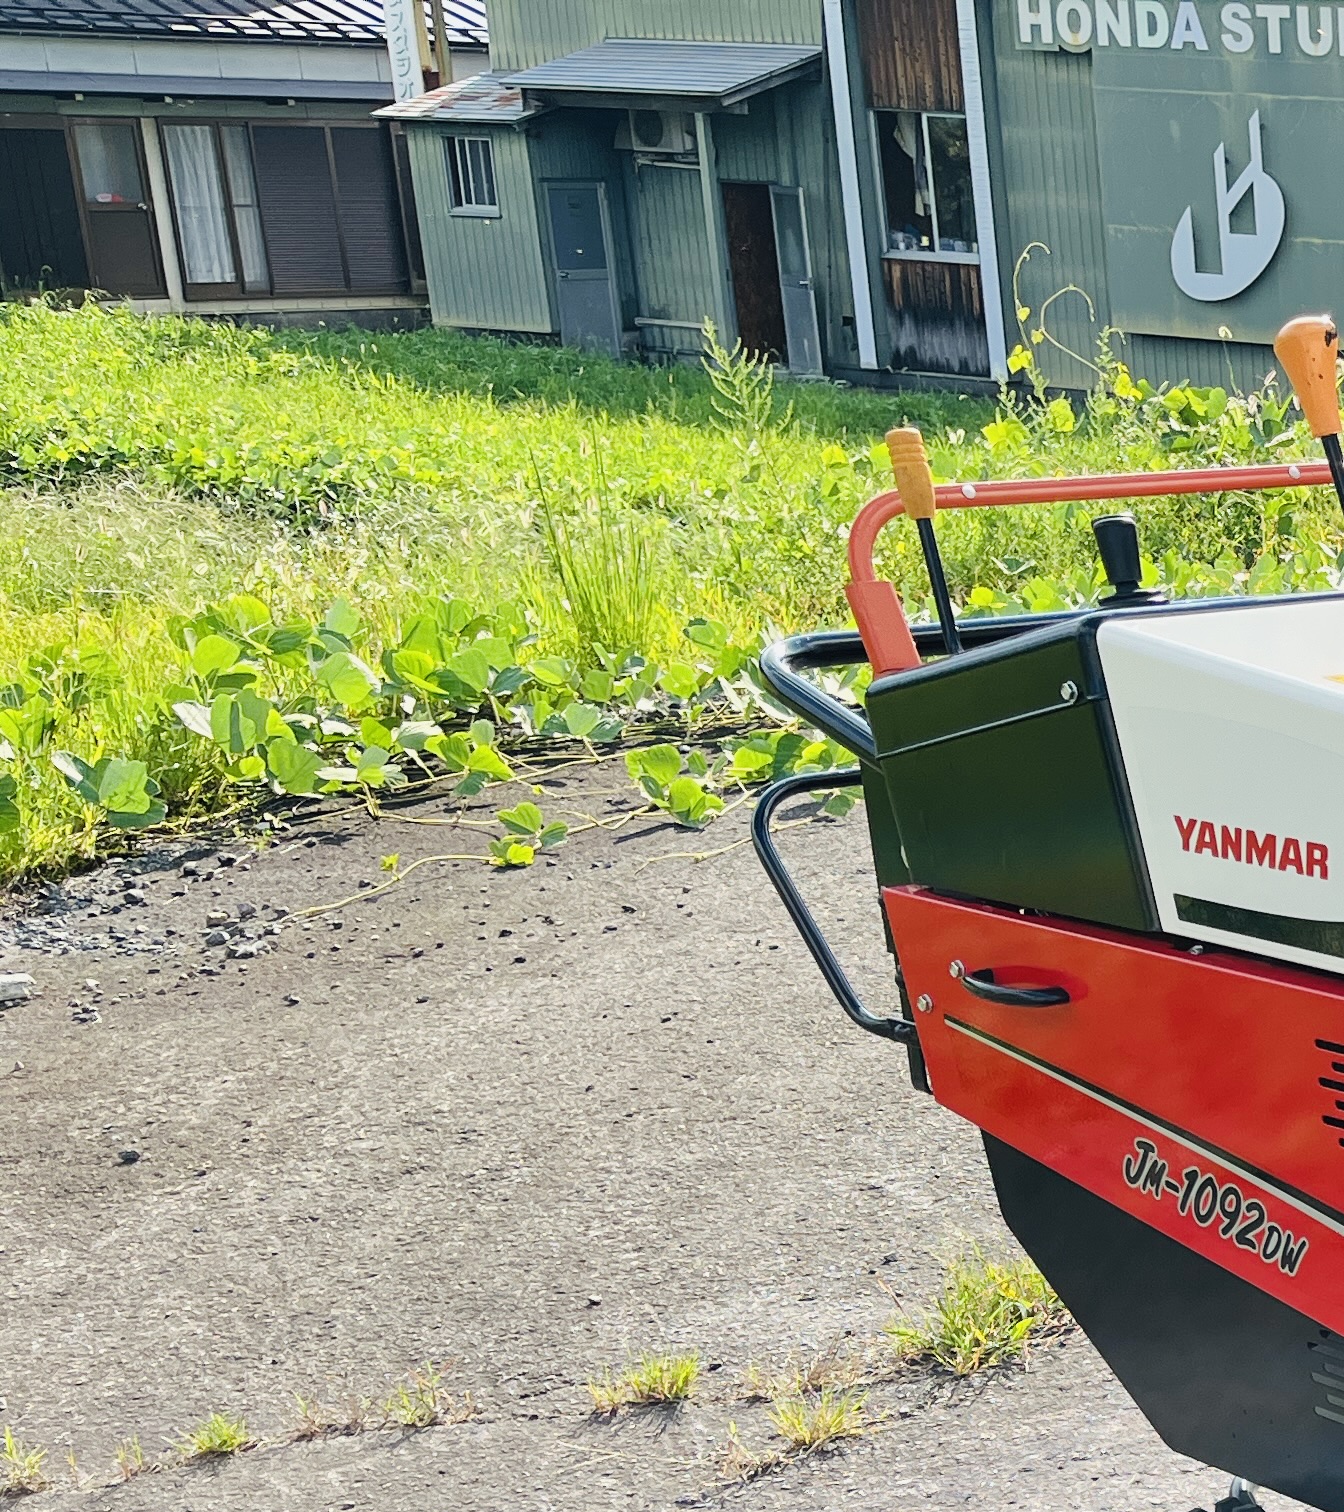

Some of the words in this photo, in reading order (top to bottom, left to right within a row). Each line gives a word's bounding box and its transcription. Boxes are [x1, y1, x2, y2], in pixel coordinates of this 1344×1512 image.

[1016, 0, 1209, 50] HONDA
[1173, 815, 1328, 880] YANMAR
[1124, 1137, 1308, 1276] JM-1092DW
